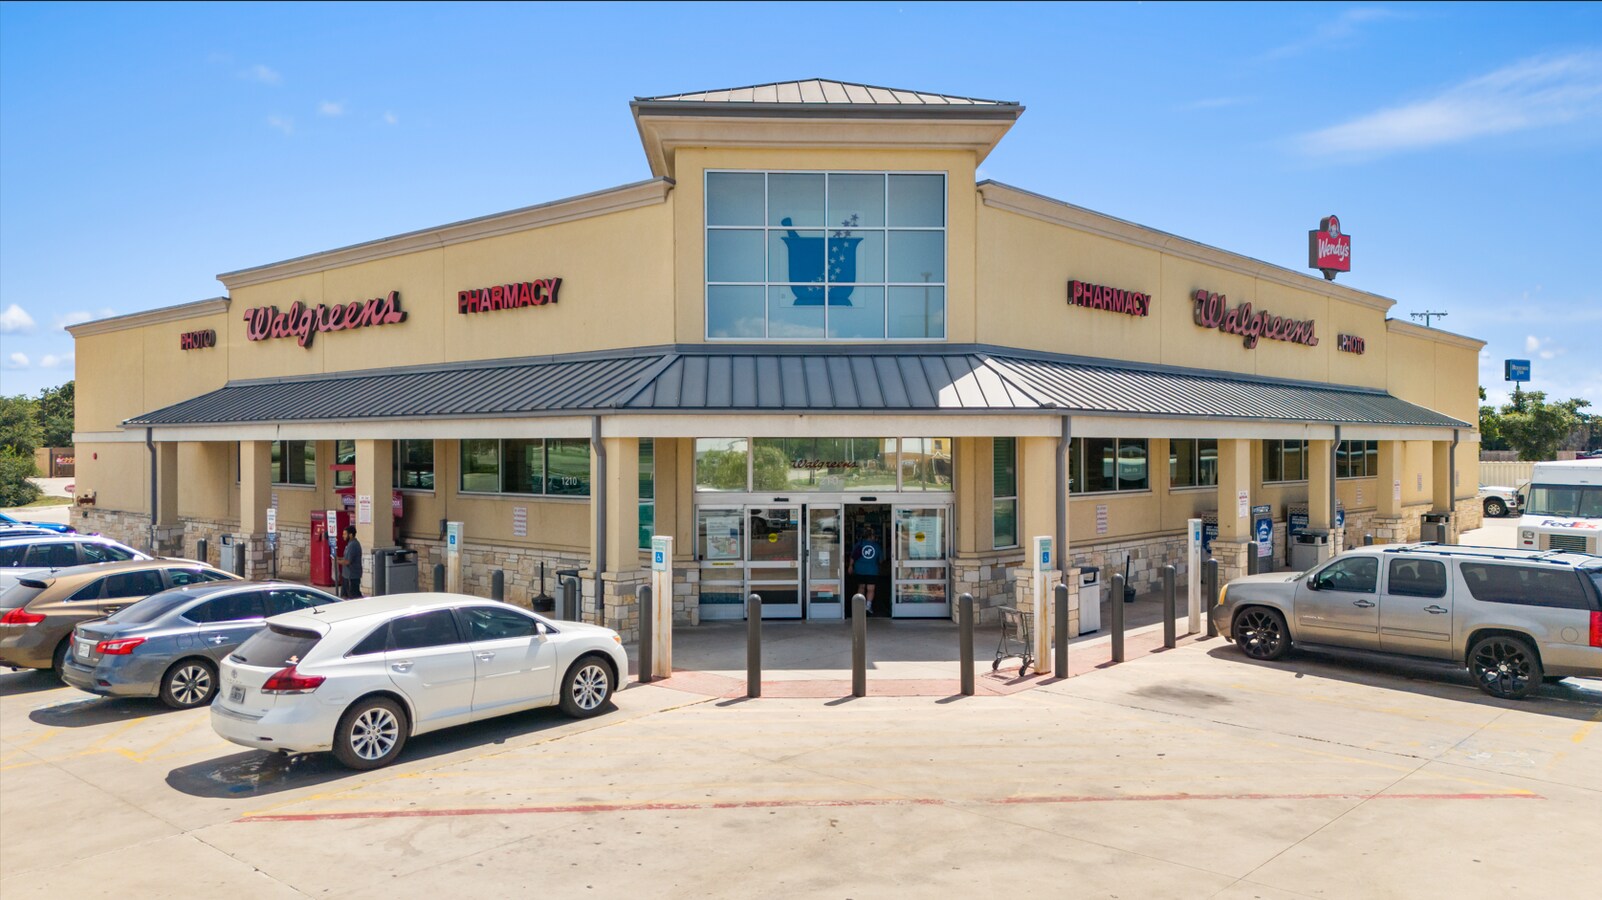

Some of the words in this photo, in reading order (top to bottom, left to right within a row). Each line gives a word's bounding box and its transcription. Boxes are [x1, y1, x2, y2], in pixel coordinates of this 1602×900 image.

[1318, 238, 1349, 262] Wendy's
[458, 278, 561, 314] PHARMACY
[1068, 280, 1151, 316] PHARMACY
[243, 291, 407, 348] Walgreens
[1193, 289, 1319, 350] Walgreens
[181, 329, 215, 350] PHOTO
[1339, 333, 1365, 355] PHOTO
[791, 459, 859, 471] Walgreens
[561, 476, 578, 486] 1210
[1541, 519, 1598, 529] FedEx
